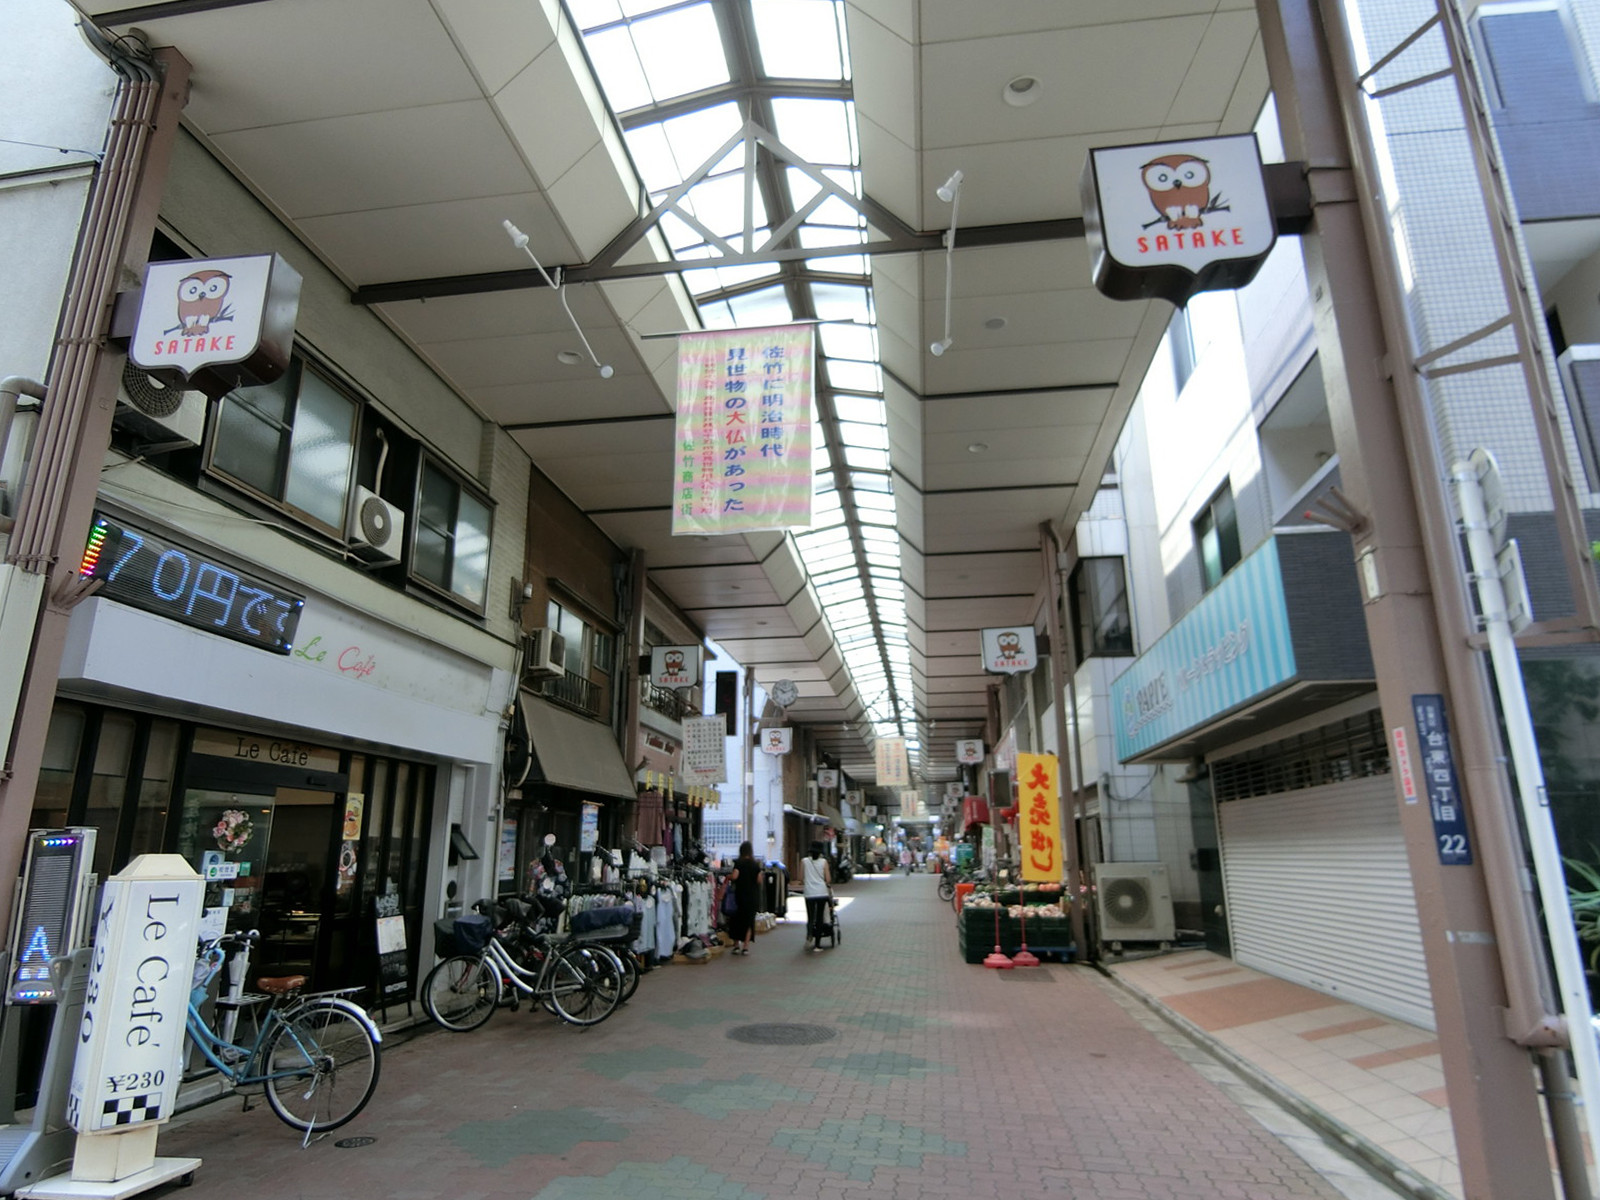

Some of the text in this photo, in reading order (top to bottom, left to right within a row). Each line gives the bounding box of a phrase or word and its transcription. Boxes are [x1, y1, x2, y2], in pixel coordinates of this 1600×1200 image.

[1136, 228, 1245, 254] SATAKE
[154, 335, 236, 356] SATAKE
[760, 345, 785, 458] 佐竹に明治時代
[723, 347, 748, 513] 見世物の大仏があった
[681, 441, 695, 516] 佐竹商店街
[294, 636, 328, 662] Le
[234, 736, 260, 759] Le
[1427, 731, 1456, 822] 台東四丁目
[1027, 762, 1053, 873] 大売出し
[1440, 834, 1467, 854] 22
[142, 893, 181, 942] Le
[106, 1069, 165, 1093] ¥230
